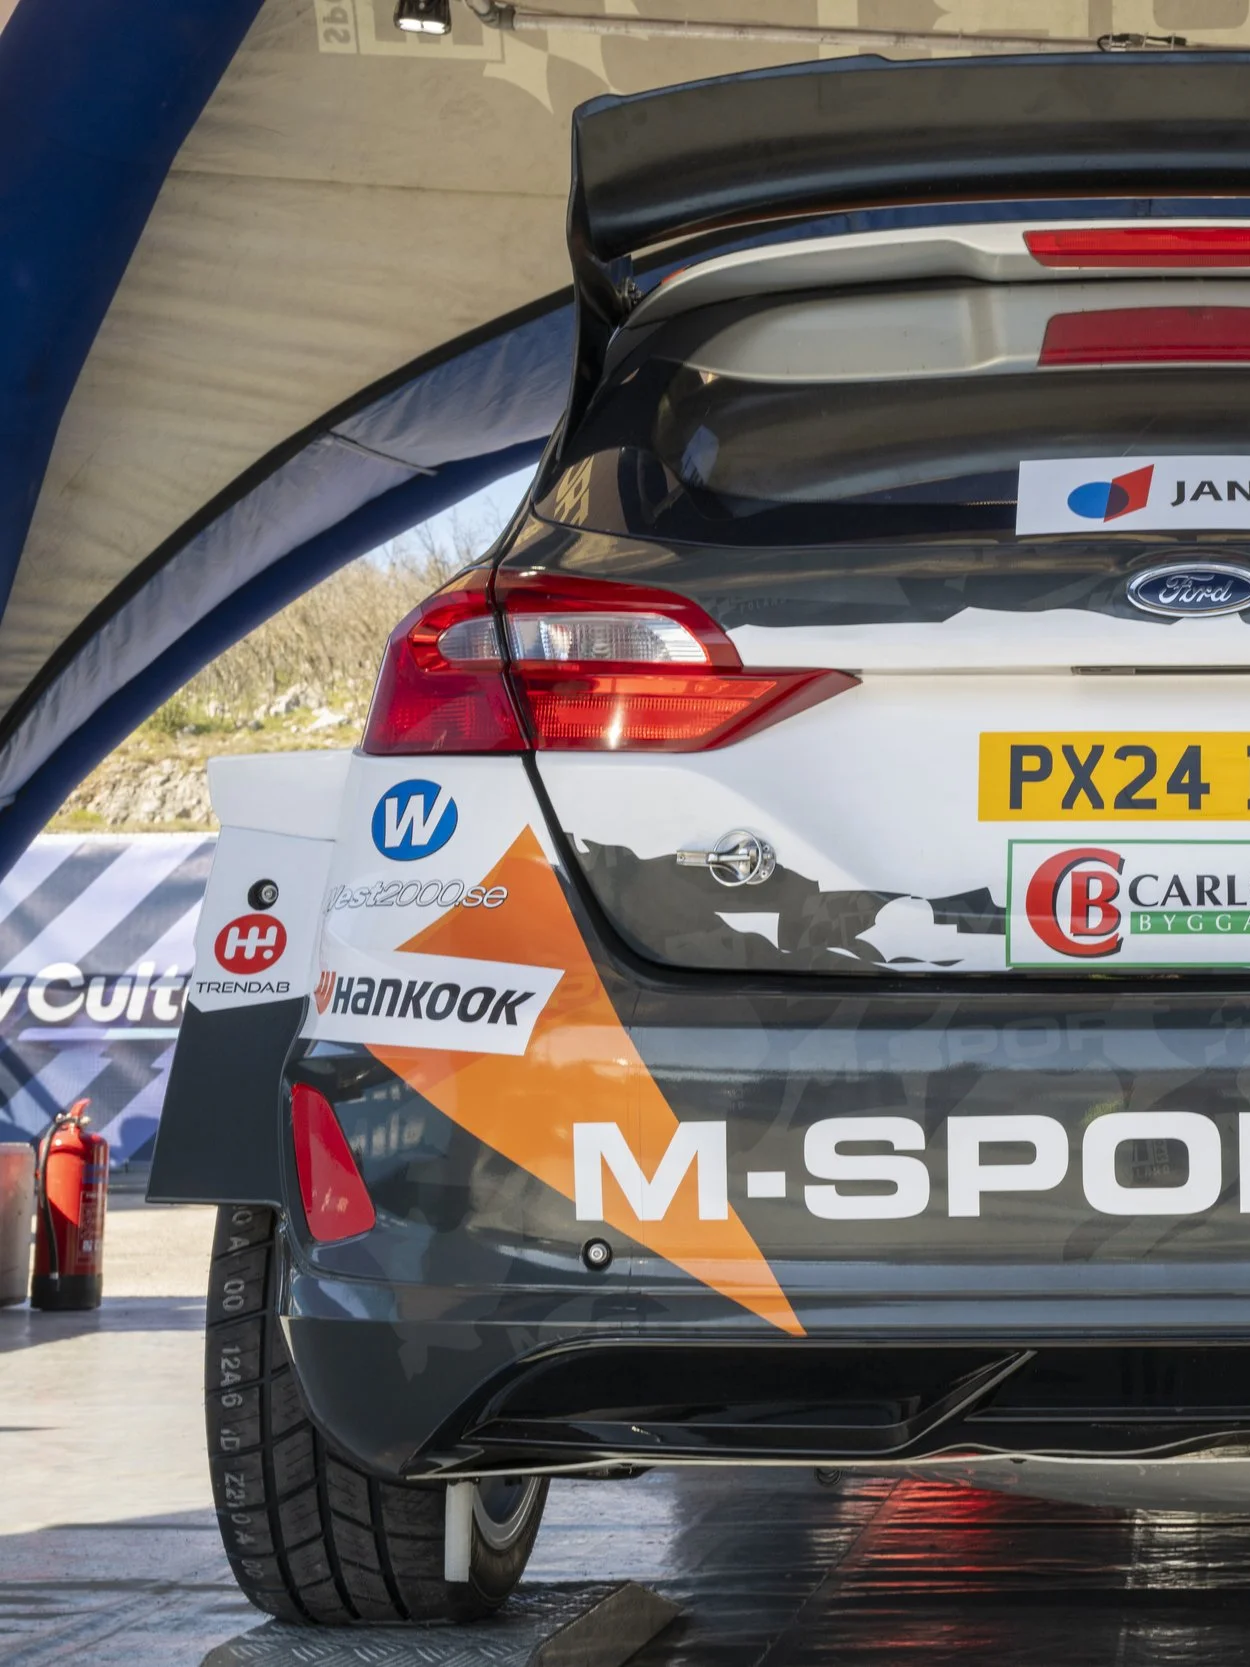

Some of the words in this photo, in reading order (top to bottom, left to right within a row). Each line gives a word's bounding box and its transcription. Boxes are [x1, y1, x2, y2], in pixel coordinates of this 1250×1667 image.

[1158, 574, 1233, 604] Ford
[1009, 744, 1210, 810] PX24
[384, 786, 452, 848] W
[0, 961, 190, 1023] yCult
[196, 981, 290, 994] TRENDAB
